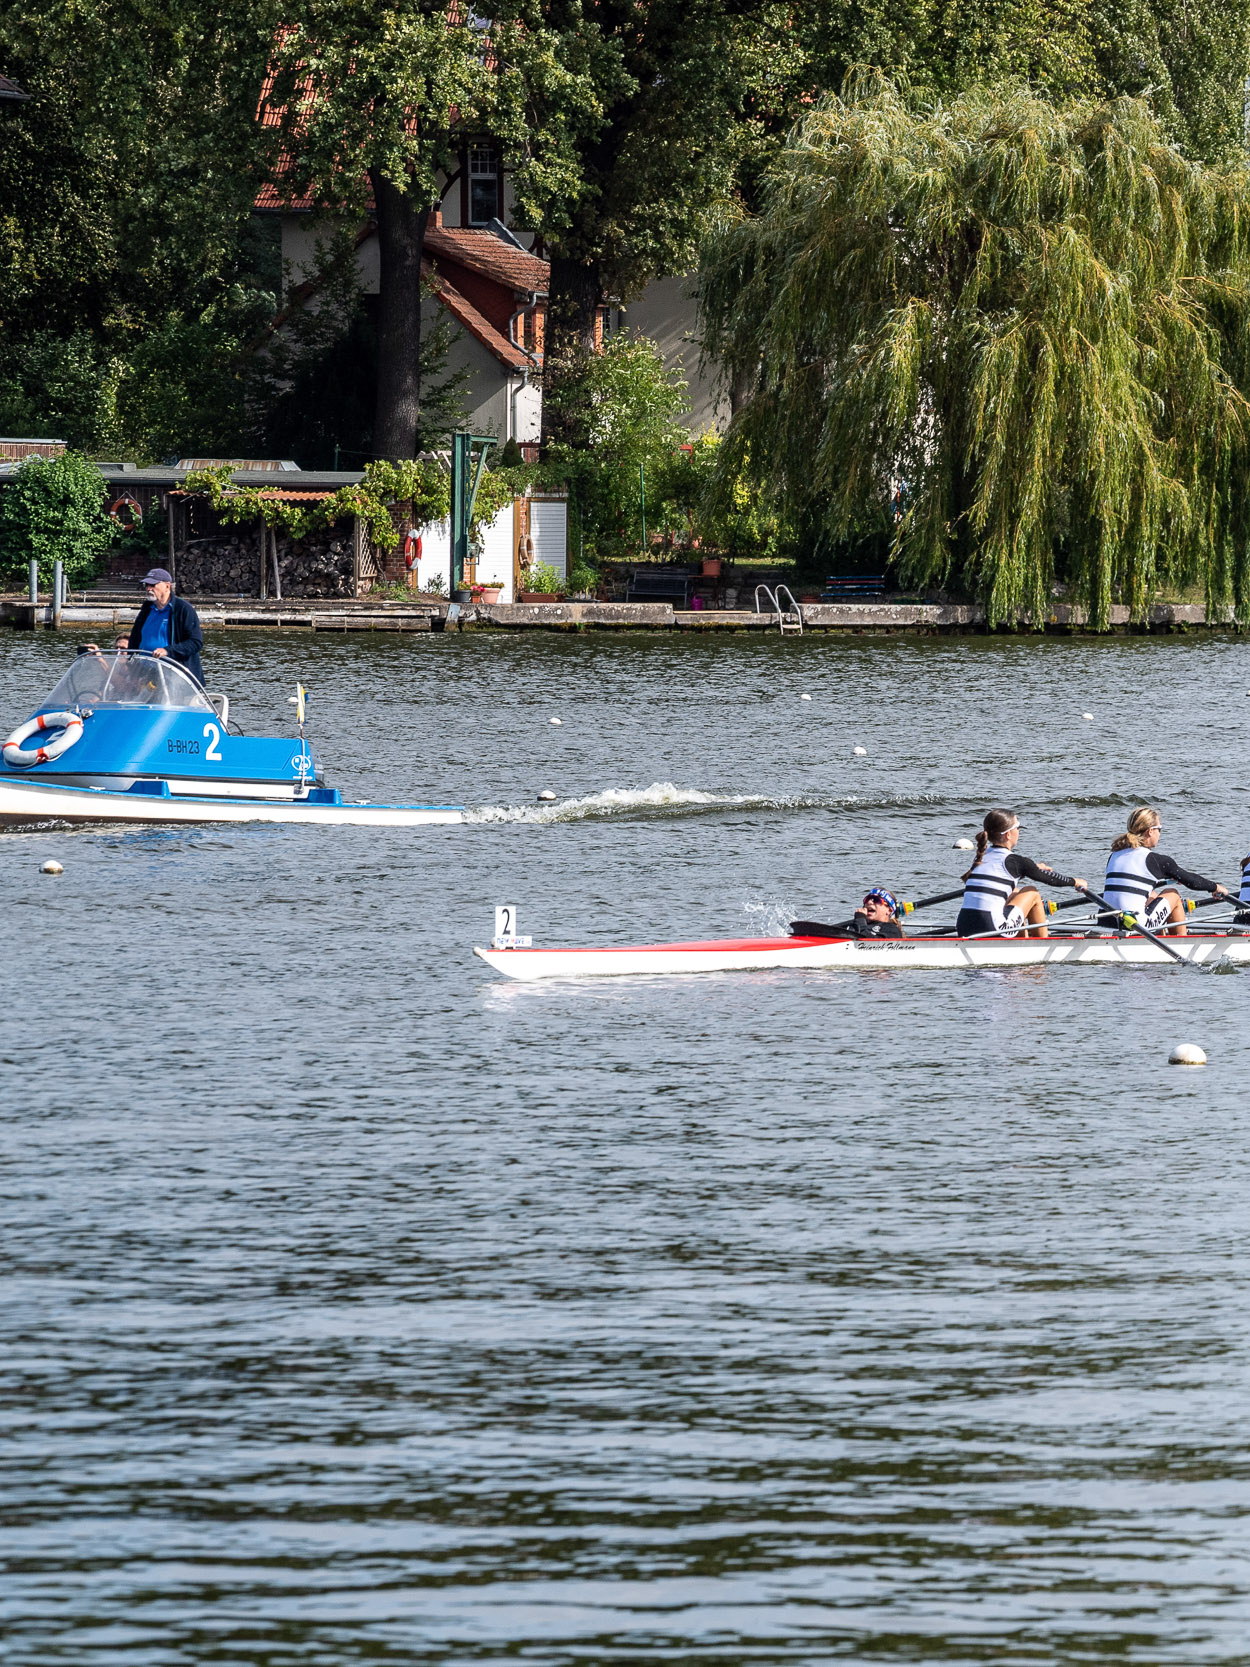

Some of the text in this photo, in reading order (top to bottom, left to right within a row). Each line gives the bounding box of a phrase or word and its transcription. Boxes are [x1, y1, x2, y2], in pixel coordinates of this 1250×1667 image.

[203, 723, 222, 761] 2
[502, 908, 510, 935] 2
[858, 943, 916, 952] Heinrich Follmann
